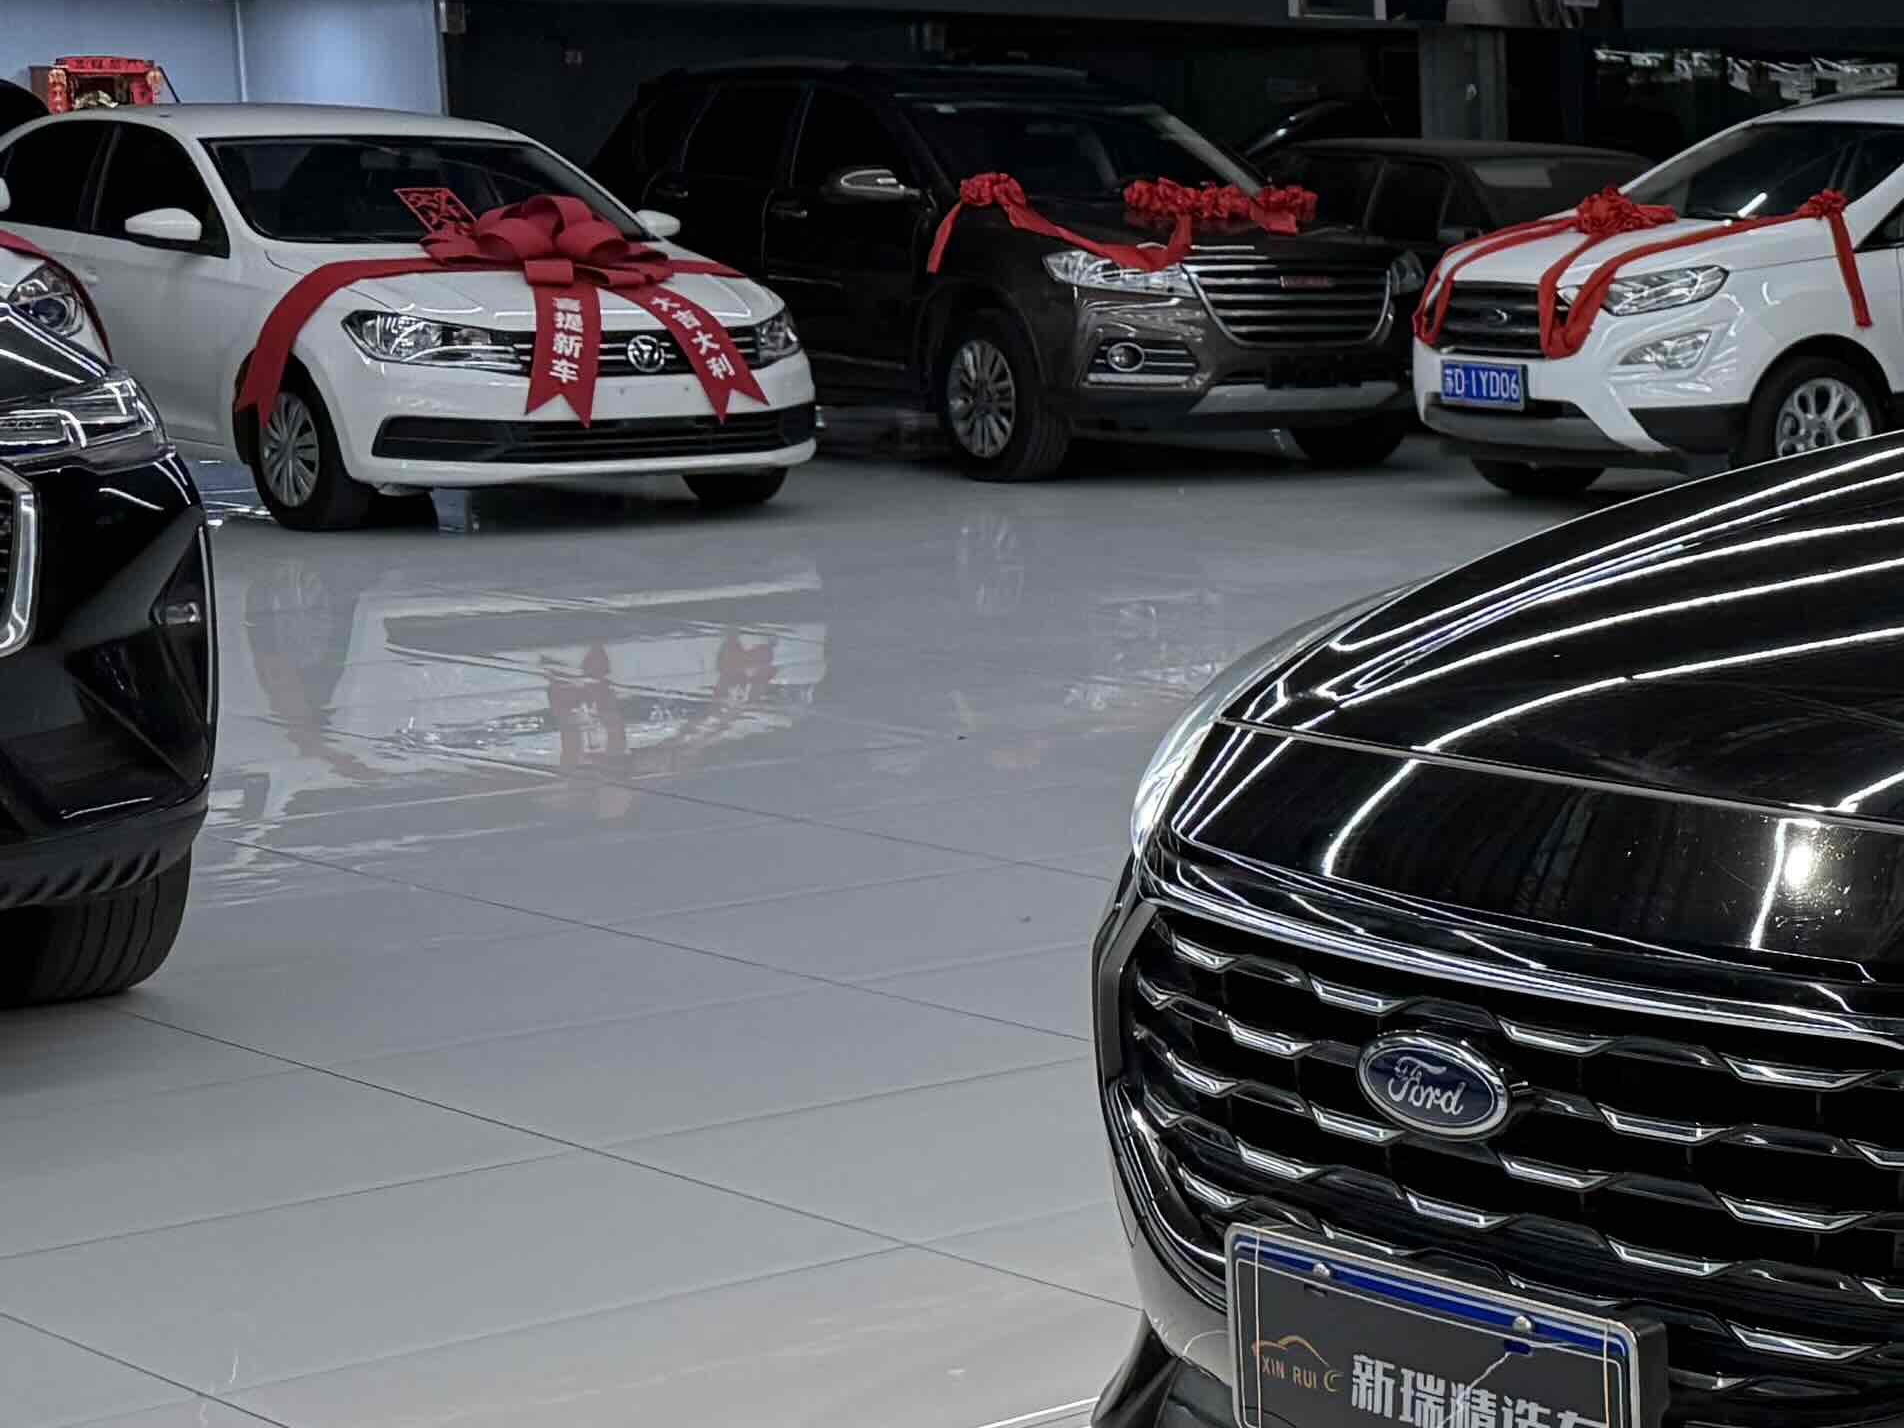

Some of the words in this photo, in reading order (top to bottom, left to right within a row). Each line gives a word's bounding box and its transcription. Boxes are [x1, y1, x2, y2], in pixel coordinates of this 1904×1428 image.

[652, 297, 736, 380] 大吉大利
[1387, 1055, 1467, 1116] Ford
[1262, 1355, 1285, 1380] XIN
[1292, 1364, 1318, 1389] RUI
